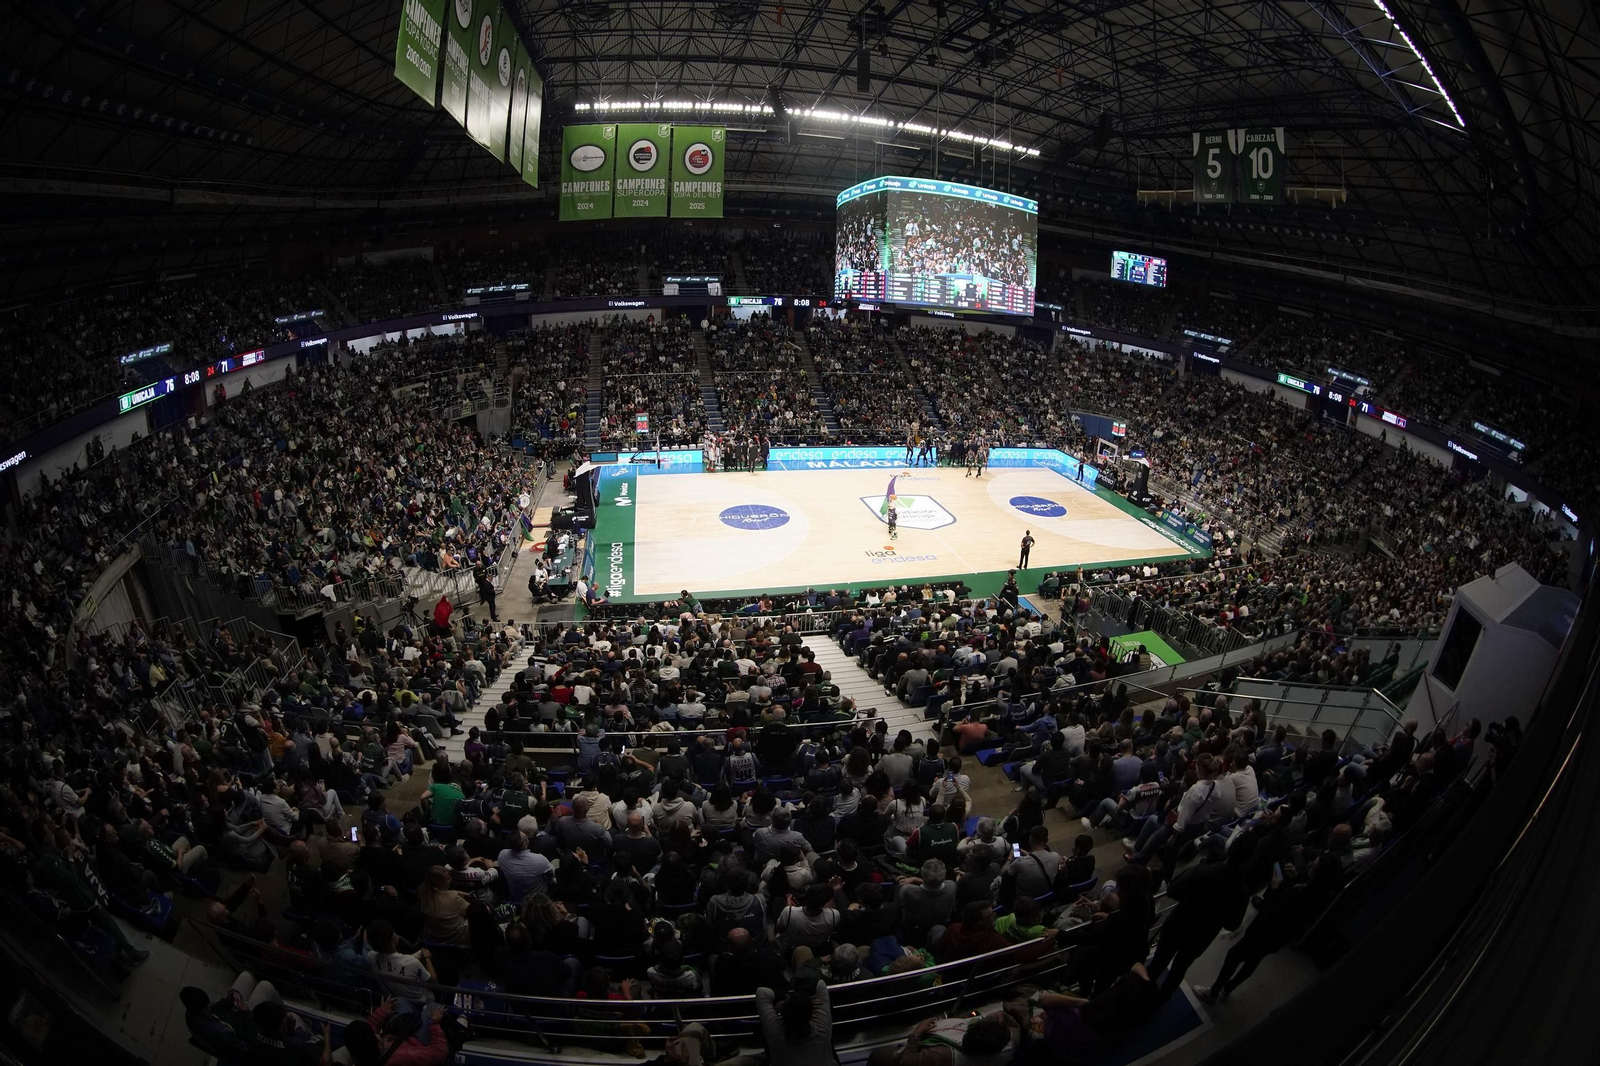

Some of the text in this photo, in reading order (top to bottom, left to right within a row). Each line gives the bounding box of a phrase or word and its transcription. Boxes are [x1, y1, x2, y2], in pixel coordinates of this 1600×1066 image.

[406, 18, 420, 43] COPA
[1205, 136, 1222, 144] BERNI
[1246, 134, 1275, 142] CABEZAS
[1207, 148, 1222, 178] 5
[1249, 147, 1273, 179] 10
[562, 181, 610, 193] CAMPEONES
[617, 179, 665, 190] CAMPEONES
[674, 182, 722, 192] CAMPEONES
[304, 338, 327, 347] Volkswagen
[132, 361, 228, 405] UNICAJA 76 8:08 24 71
[1313, 384, 1320, 395] 76
[1328, 391, 1342, 402] 8:08
[1361, 402, 1368, 413] 71
[776, 449, 823, 460] endesa
[832, 449, 877, 459] endesa
[990, 450, 1027, 459] endesa
[1033, 450, 1064, 463] endesa
[1067, 459, 1093, 478] ensa
[1098, 473, 1114, 485] endesa
[872, 555, 937, 564] endesa
[606, 543, 625, 597] #ligaendesa
[221, 724, 227, 737] 9
